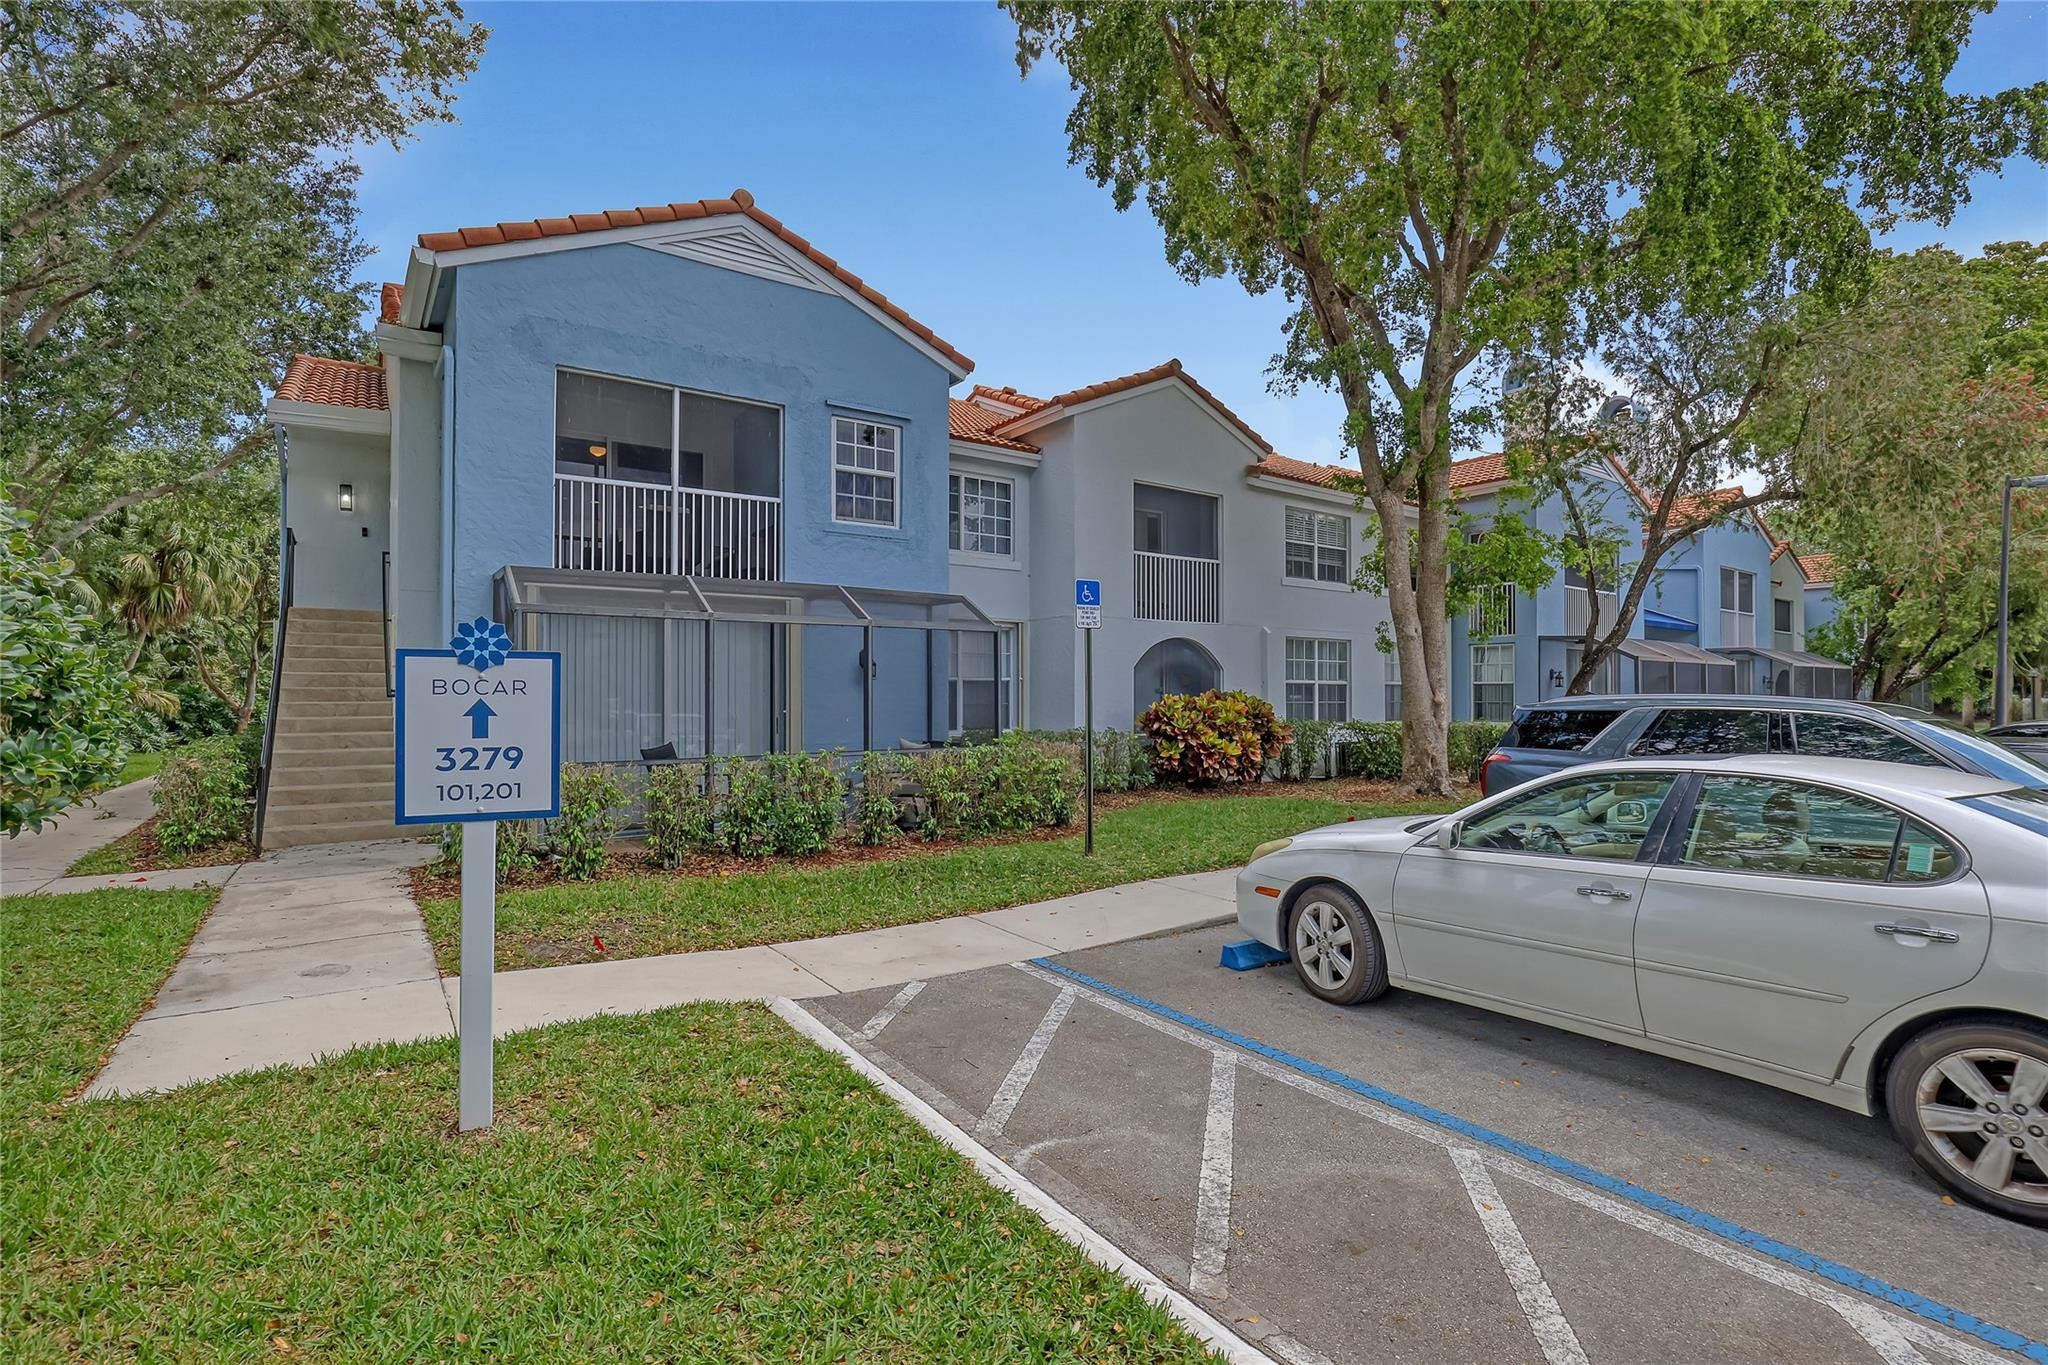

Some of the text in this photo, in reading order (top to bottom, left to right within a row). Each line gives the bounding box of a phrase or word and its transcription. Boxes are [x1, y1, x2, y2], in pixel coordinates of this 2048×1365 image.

[432, 679, 527, 696] BOCAR
[434, 746, 524, 772] 3279
[436, 782, 522, 803] 101,201
